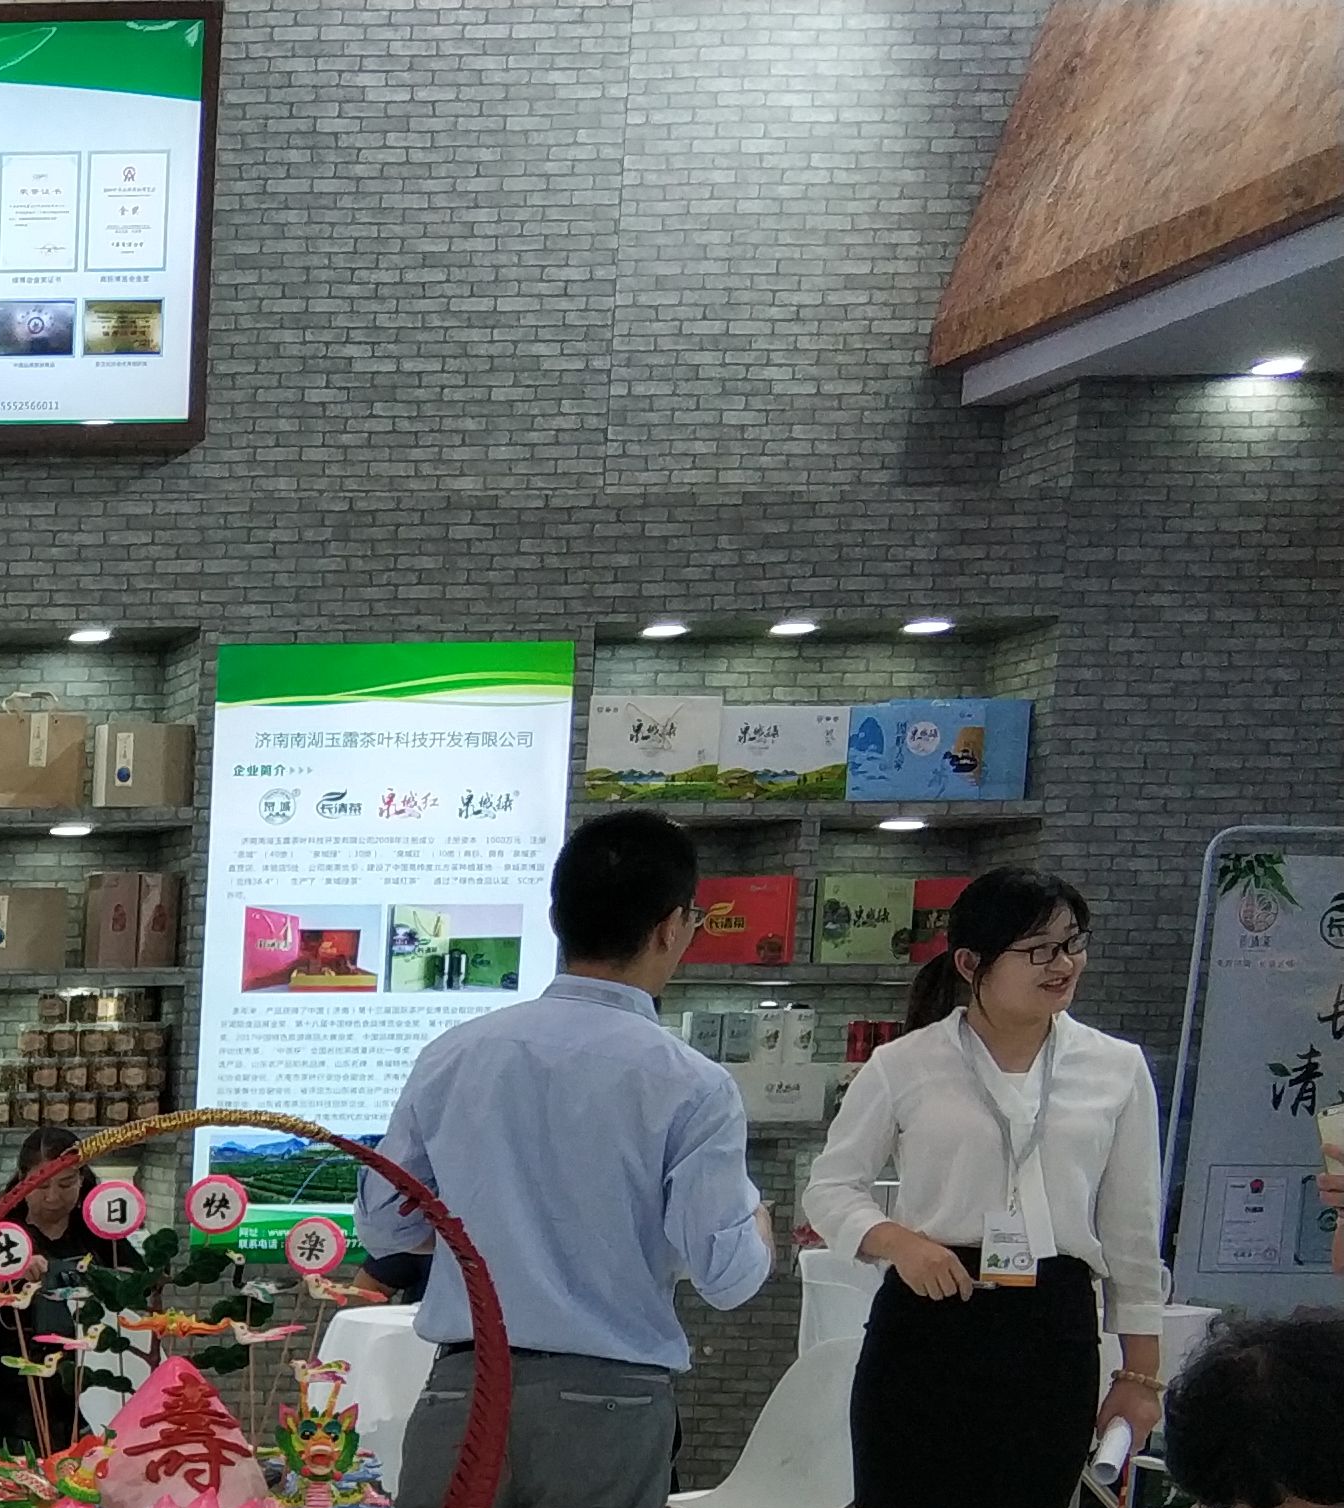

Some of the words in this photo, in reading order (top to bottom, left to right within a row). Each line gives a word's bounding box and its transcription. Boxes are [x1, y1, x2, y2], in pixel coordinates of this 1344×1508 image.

[254, 731, 534, 749] 济南南湖玉露茶叶科技开发有限公司
[233, 764, 287, 777] 企业简介
